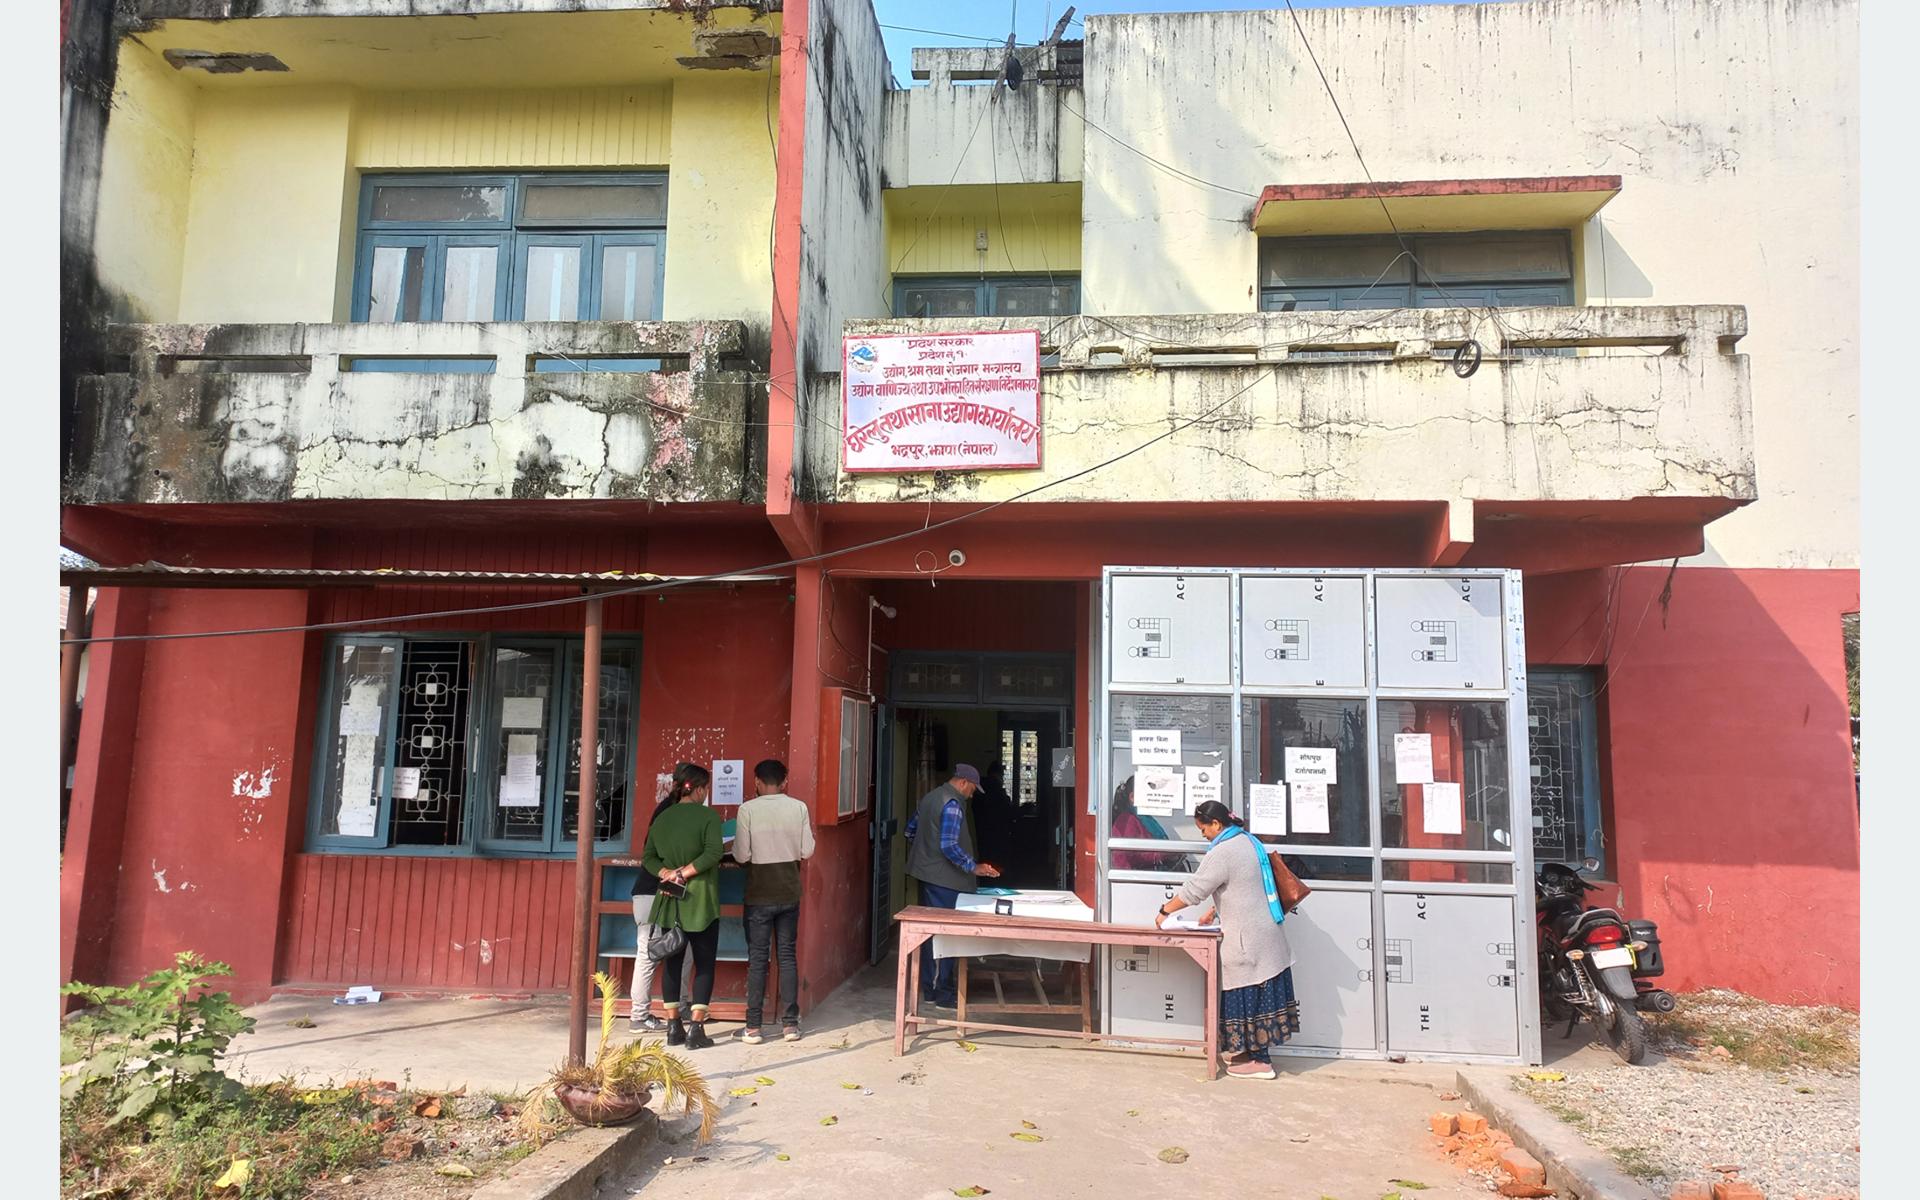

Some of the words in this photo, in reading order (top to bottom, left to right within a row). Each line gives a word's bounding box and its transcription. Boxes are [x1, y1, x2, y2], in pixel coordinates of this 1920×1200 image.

[938, 338, 974, 347] सरकार
[918, 348, 944, 360] प्रदेश
[908, 365, 924, 376] श्रम
[926, 364, 944, 377] तथा
[946, 362, 980, 377] रोजगार
[982, 362, 1021, 374] मन्त्रालय
[852, 381, 874, 397] उद्योग
[906, 402, 942, 425] साना
[943, 396, 980, 425] उद्योग
[978, 405, 1039, 447] कार्यालय
[958, 440, 998, 457] (नेपाल)
[1165, 994, 1174, 1020] THE
[1420, 1005, 1430, 1031] THE
